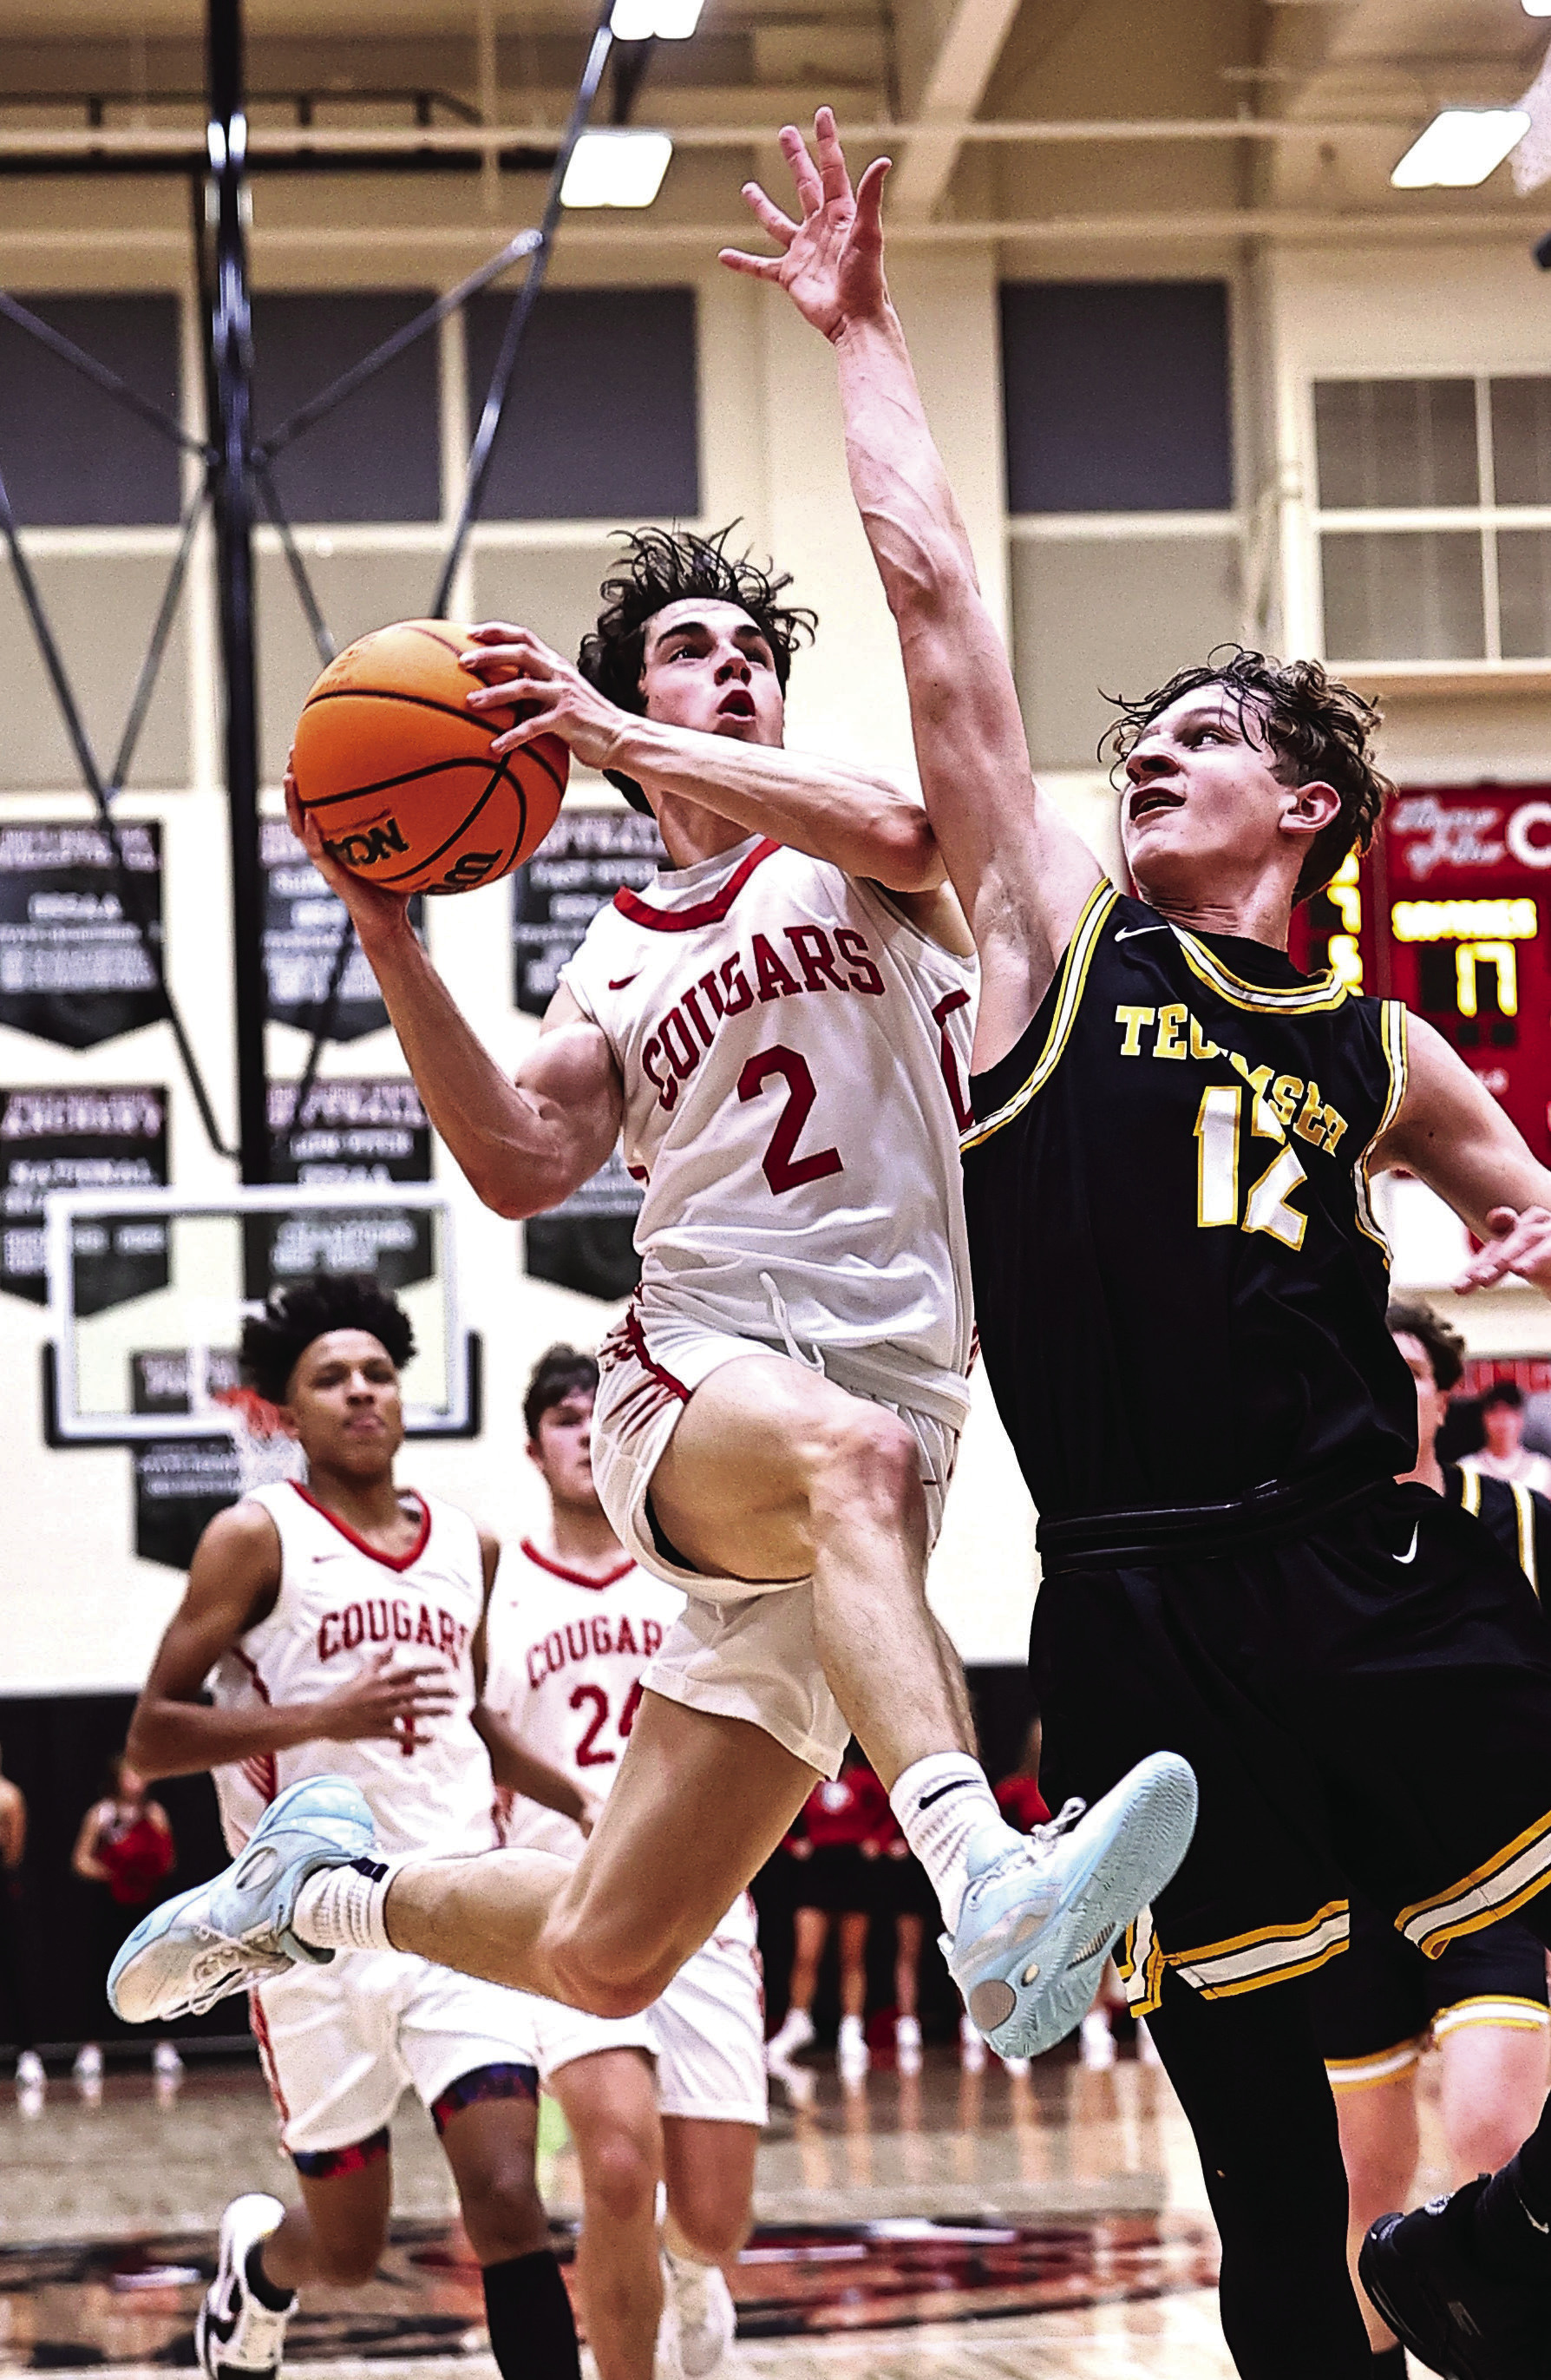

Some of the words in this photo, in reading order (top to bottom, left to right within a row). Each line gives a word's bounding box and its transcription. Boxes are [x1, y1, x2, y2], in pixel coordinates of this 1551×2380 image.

[642, 925, 886, 1111] COUGARS
[736, 1044, 844, 1196] 2
[1193, 1085, 1308, 1251] 12
